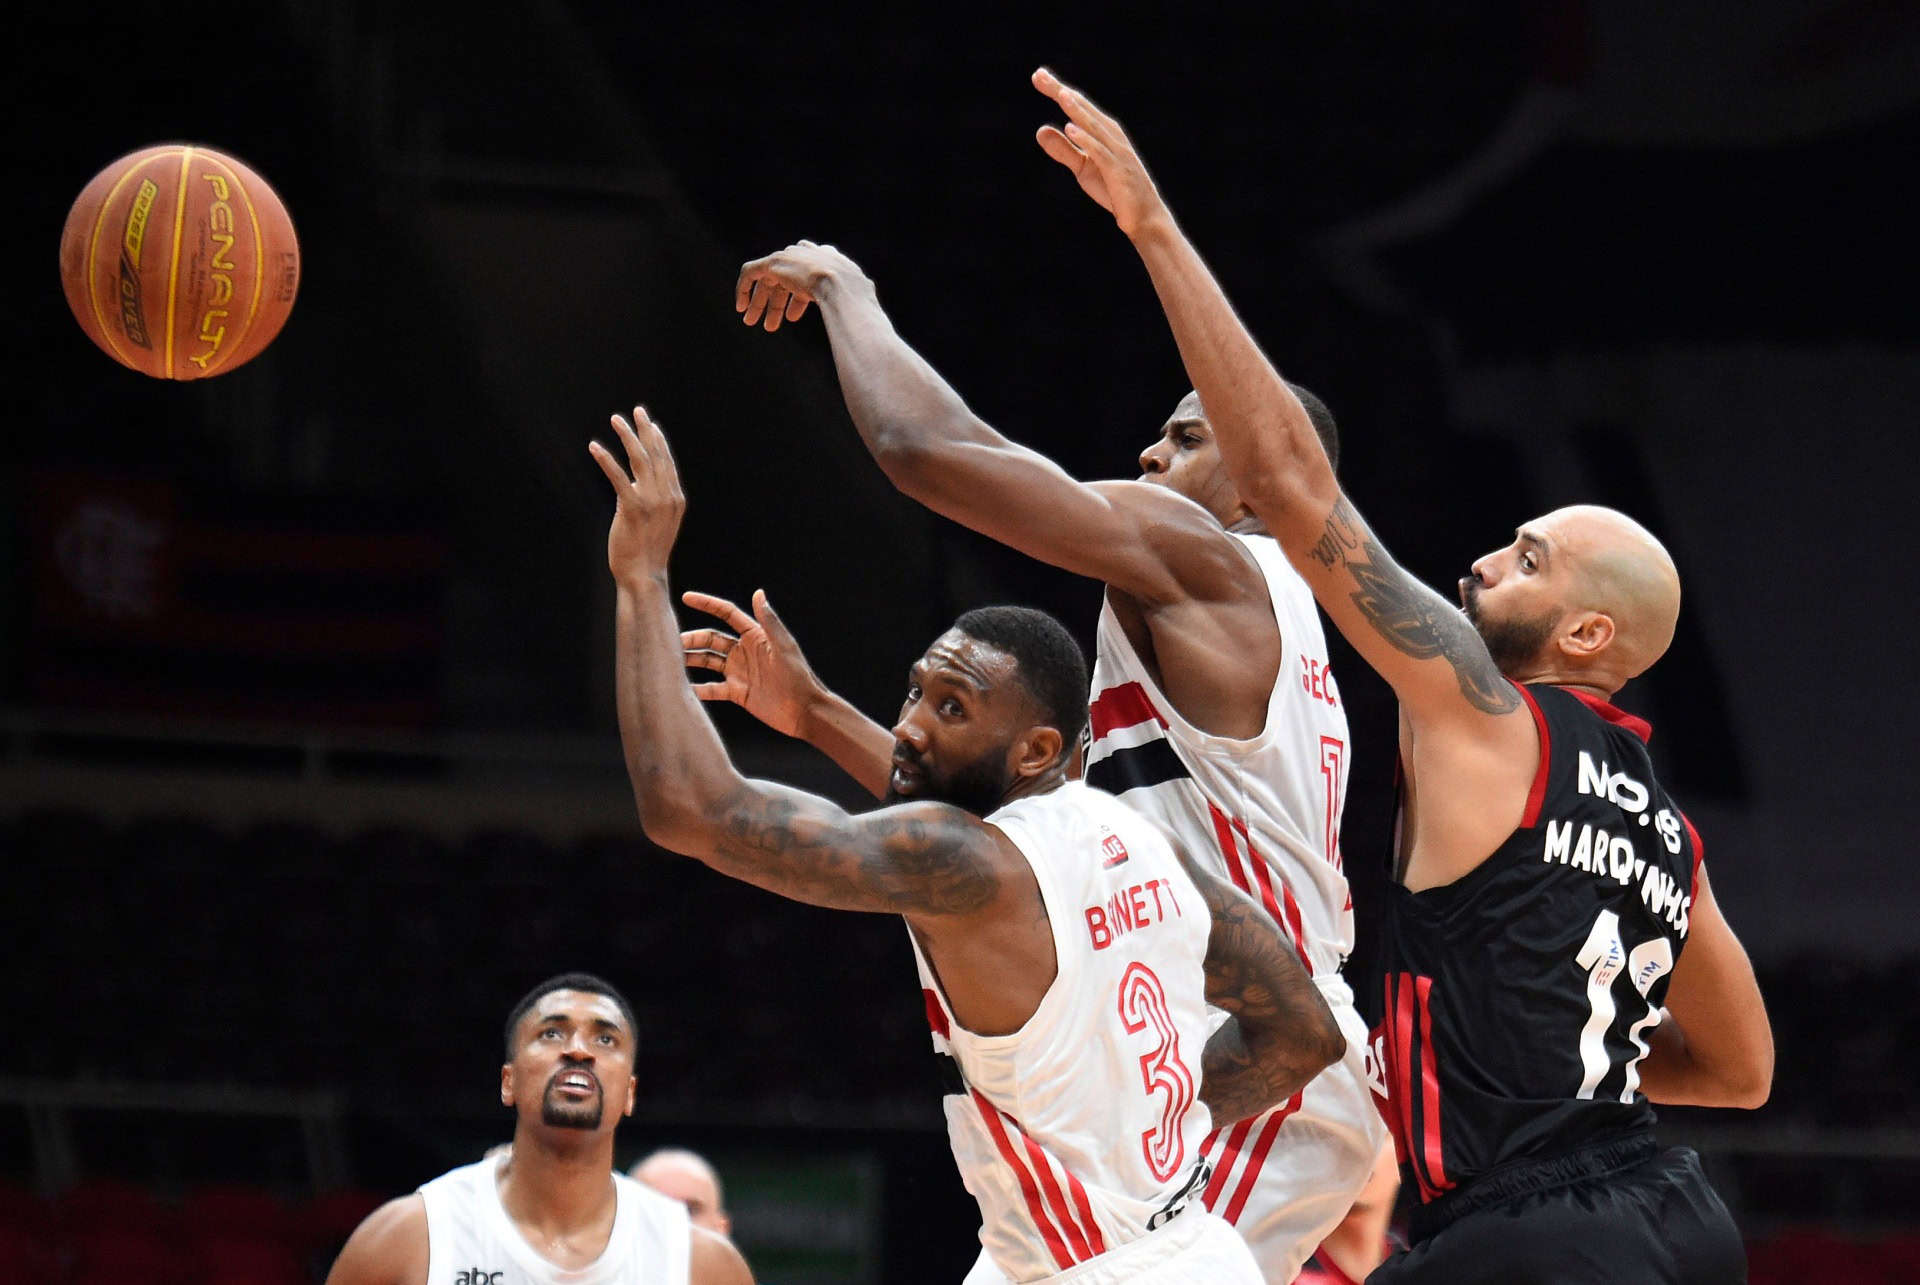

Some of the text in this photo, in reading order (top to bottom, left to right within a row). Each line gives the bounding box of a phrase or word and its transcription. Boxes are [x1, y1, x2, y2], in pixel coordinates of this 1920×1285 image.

[189, 173, 235, 368] PENALTY
[121, 281, 145, 346] OVER
[1603, 940, 1619, 969] TIM
[1118, 961, 1194, 1184] 3
[454, 1267, 504, 1285] abc
